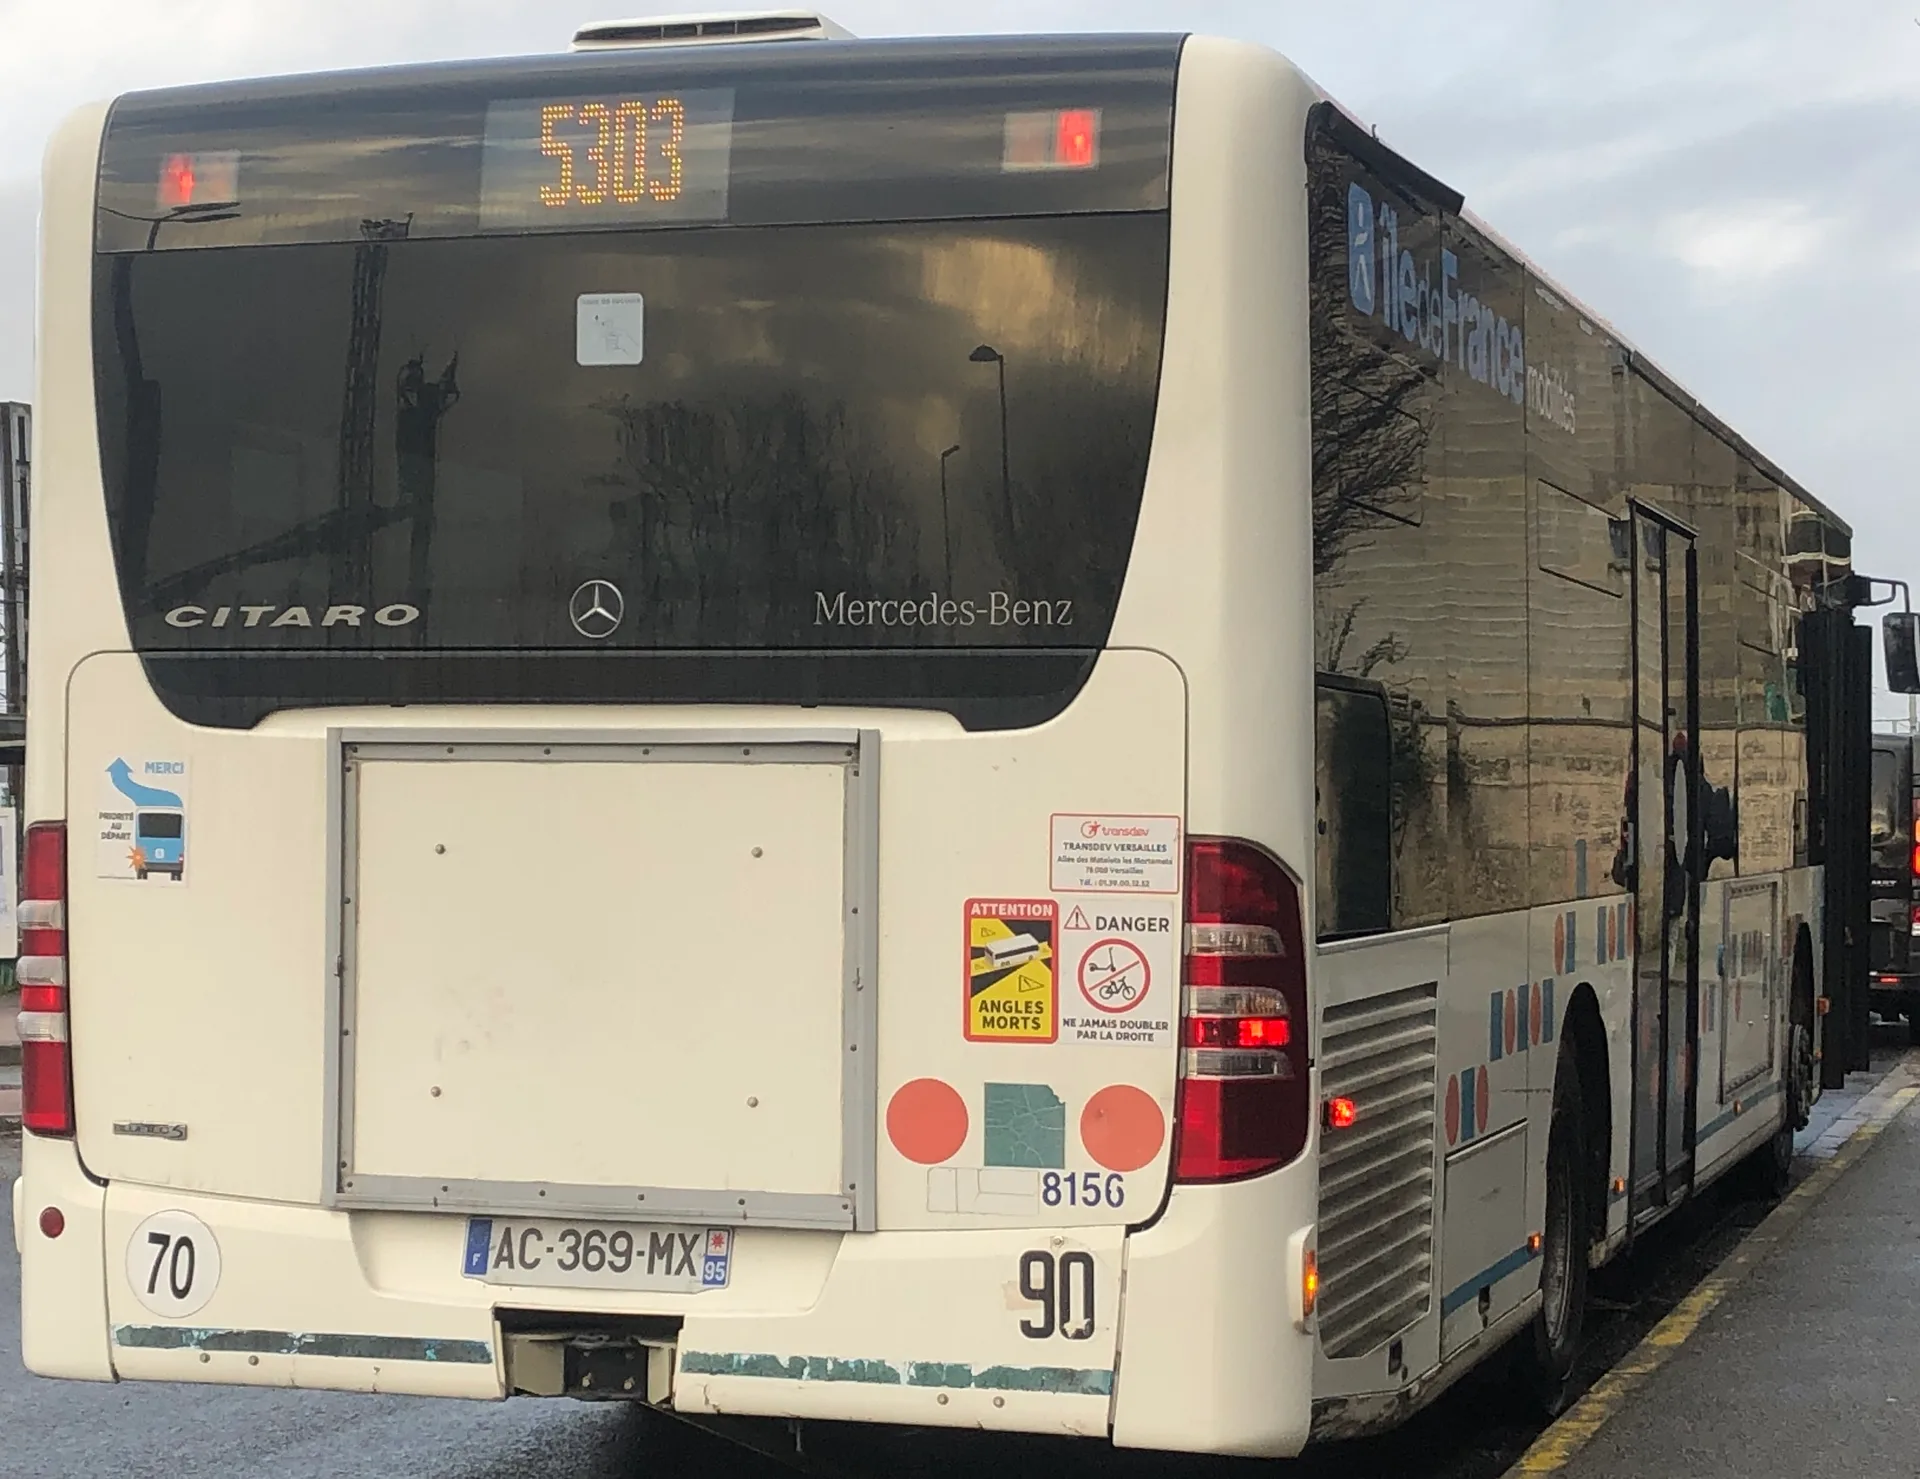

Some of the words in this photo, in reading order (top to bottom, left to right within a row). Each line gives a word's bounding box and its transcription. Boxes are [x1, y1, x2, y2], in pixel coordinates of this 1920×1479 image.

[540, 99, 684, 206] 5303
[164, 603, 420, 628] CITARO
[813, 591, 1073, 626] Mercedes-Benz
[144, 762, 184, 774] MERCI
[98, 812, 134, 821] PRIORITÉ
[111, 822, 122, 830] AU
[1102, 826, 1149, 837] transdev
[101, 831, 132, 840] DÉPART
[1063, 842, 1112, 852] TRANSDEV
[1114, 844, 1168, 853] VERSAILLES
[1076, 856, 1089, 864] des
[971, 903, 1053, 916] ATTENTION
[1095, 916, 1169, 932] DANGER
[978, 1000, 1044, 1014] ANGLES
[982, 1015, 1041, 1030] MORTS
[1063, 1018, 1077, 1027] NE
[1079, 1018, 1118, 1029] JAMAIS
[1119, 1020, 1169, 1031] DOUBLER
[1076, 1030, 1098, 1040] PAR
[1100, 1031, 1113, 1040] LA
[1115, 1032, 1154, 1042] DROITE
[1042, 1171, 1124, 1208] 8156
[493, 1226, 700, 1277] AC-369-MX
[147, 1231, 195, 1300] 70
[471, 1252, 481, 1266] F
[704, 1262, 725, 1281] 95
[1019, 1250, 1095, 1340] 90
